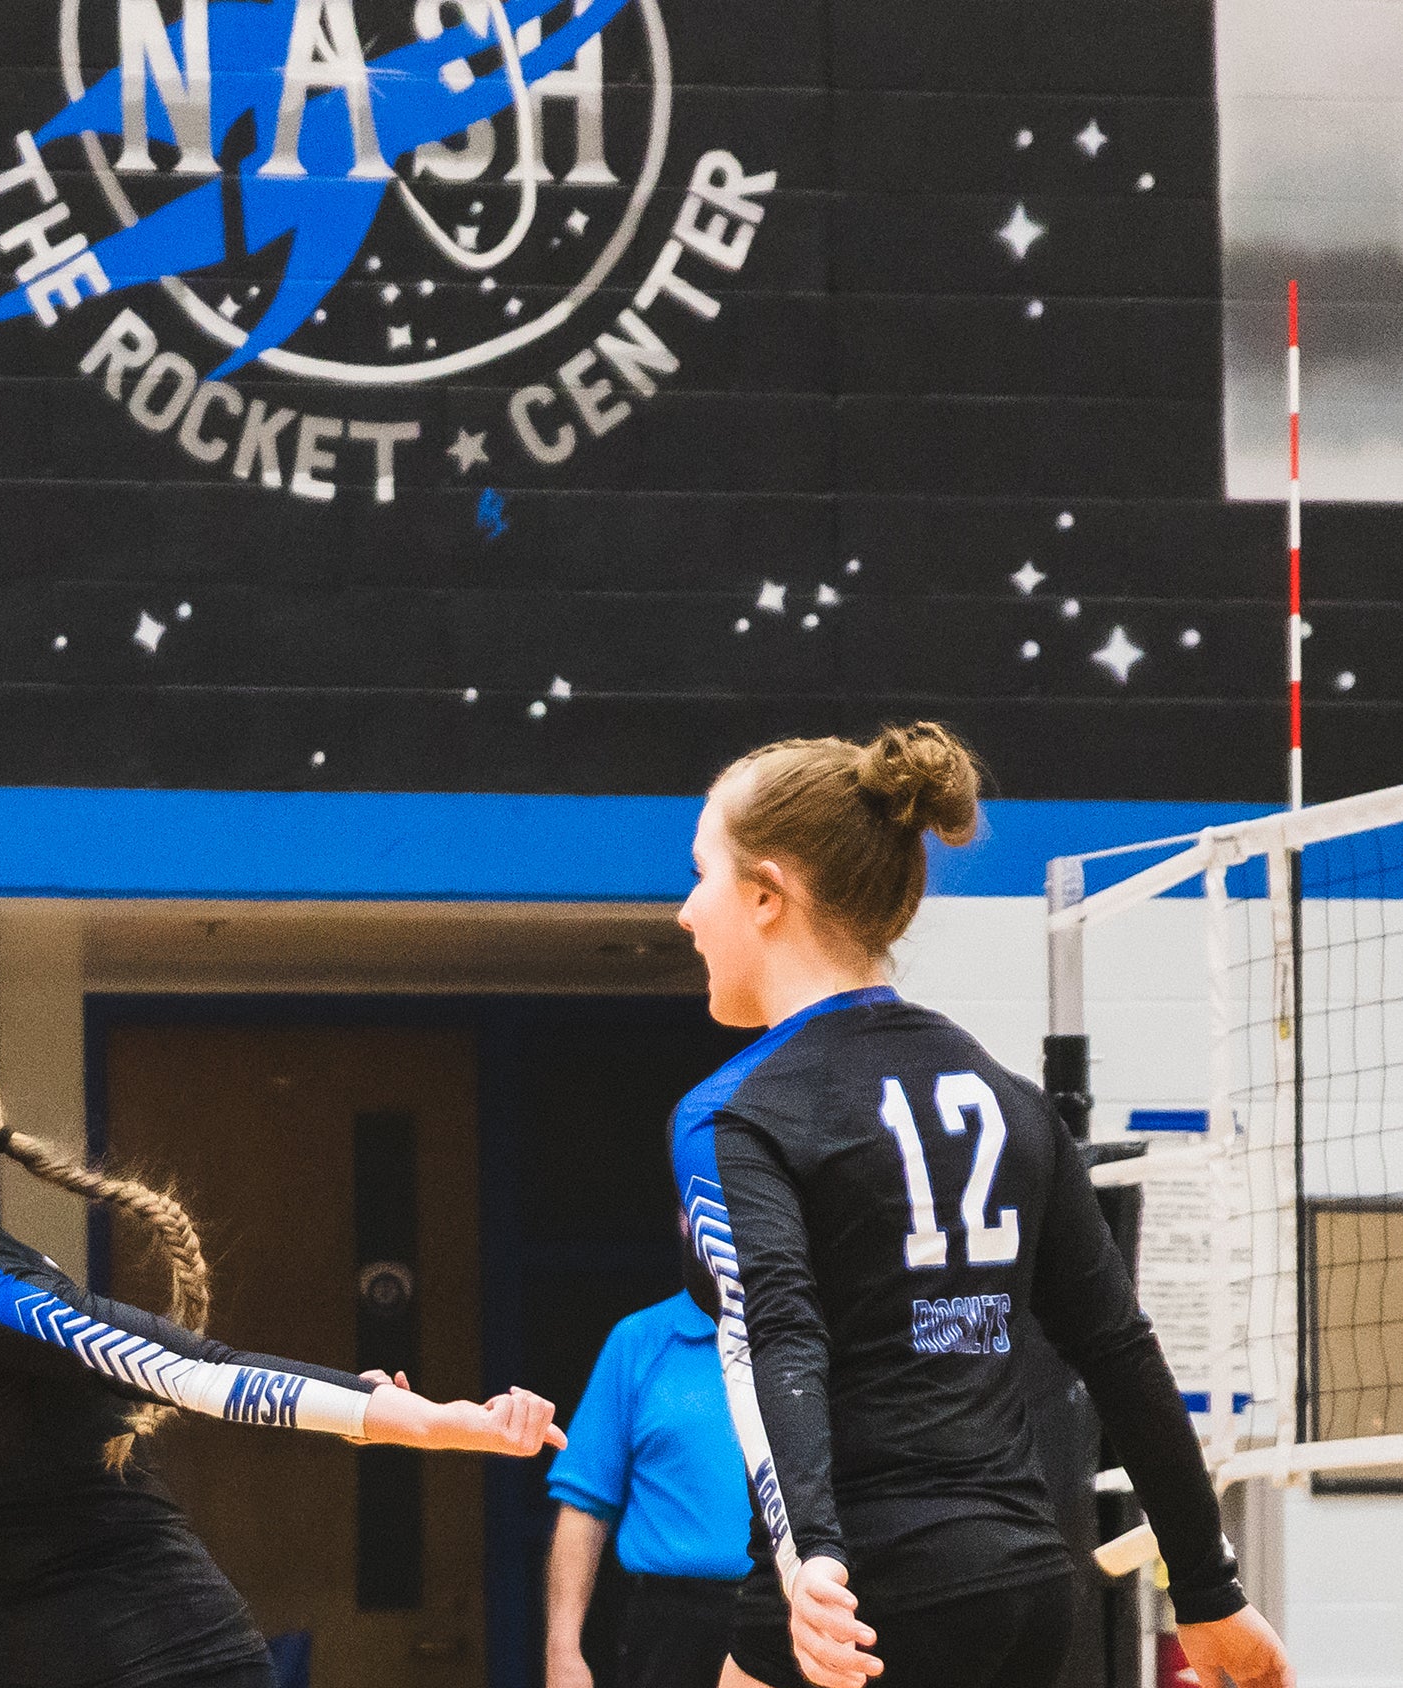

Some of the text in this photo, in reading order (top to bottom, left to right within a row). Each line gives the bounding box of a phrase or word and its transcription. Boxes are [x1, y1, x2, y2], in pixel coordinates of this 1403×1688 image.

[79, 307, 421, 504] ROCKET
[508, 148, 778, 466] CENTER
[880, 1072, 1019, 1268] 12
[223, 1366, 307, 1429] NASH
